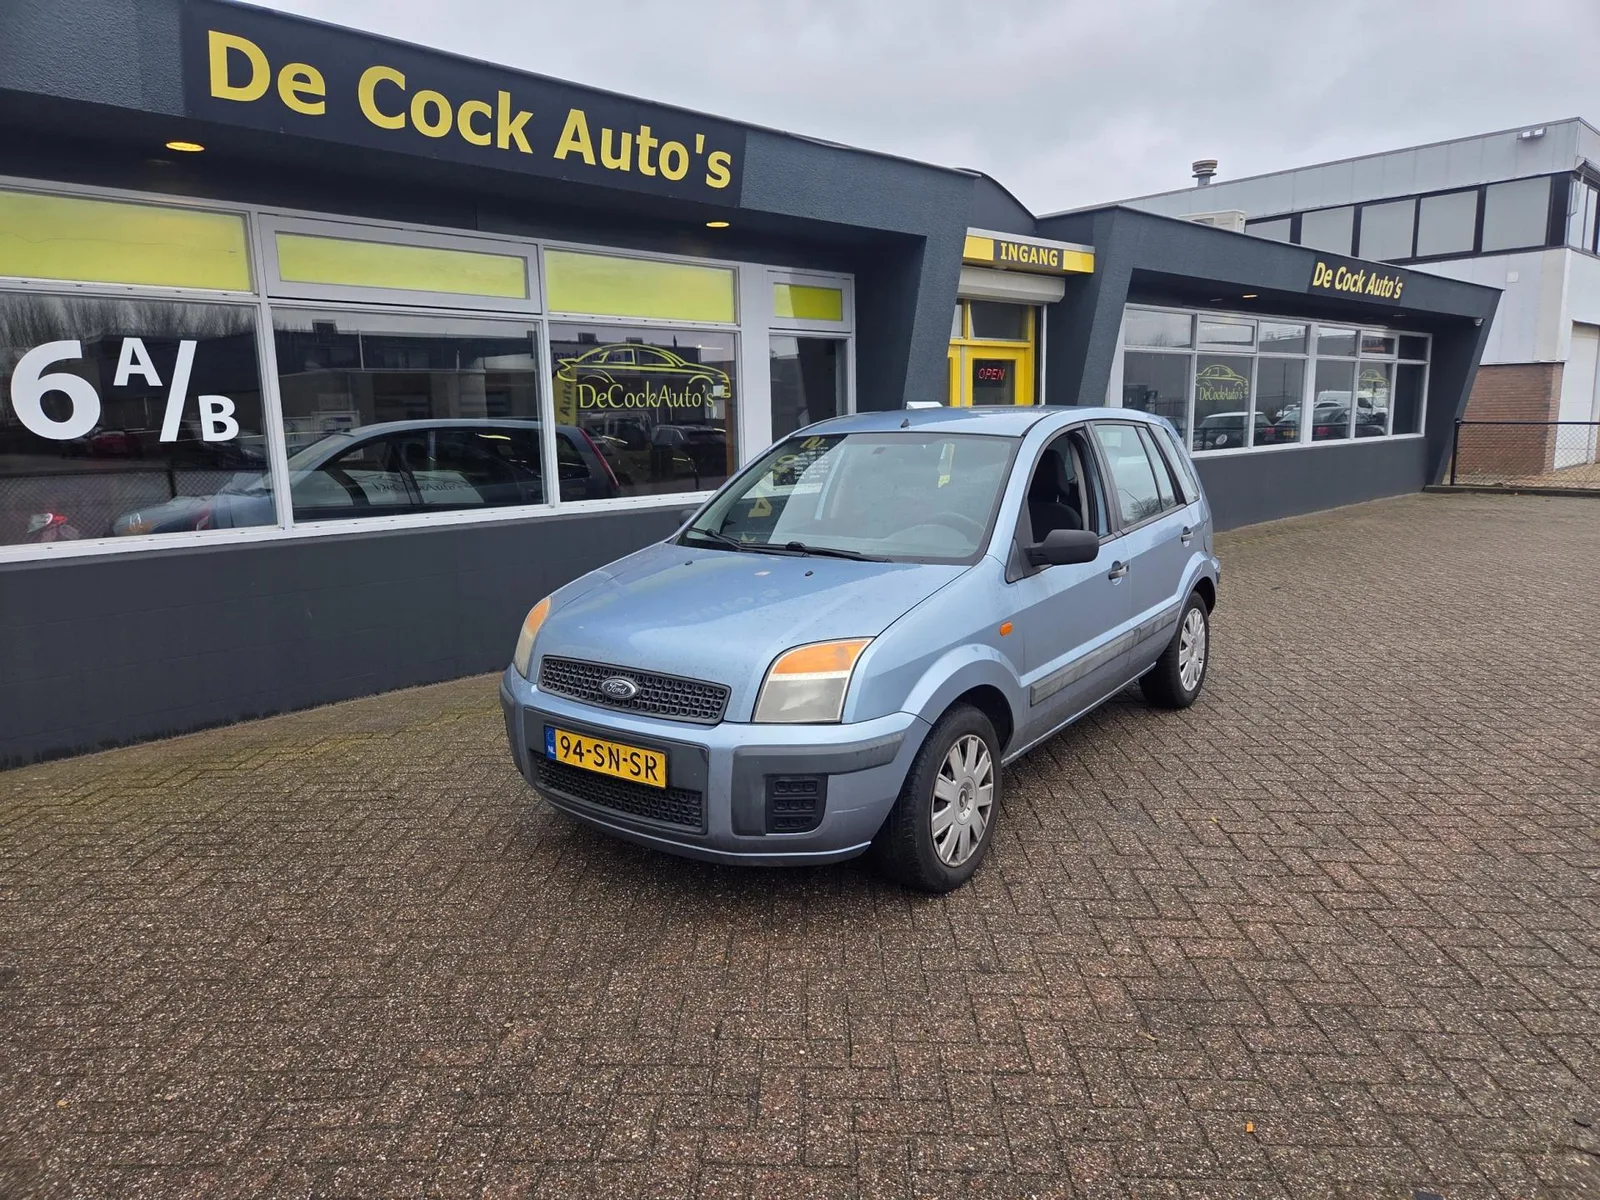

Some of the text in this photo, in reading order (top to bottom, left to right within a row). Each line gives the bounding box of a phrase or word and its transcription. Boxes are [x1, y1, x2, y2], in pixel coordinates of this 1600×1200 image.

[208, 30, 732, 190] De Cock Auto's
[1000, 242, 1058, 267] INGANG
[1312, 262, 1403, 299] De Cock Auto's
[978, 367, 1005, 381] OPEN
[577, 381, 715, 408] DeCockAuto's
[606, 682, 628, 695] Ford
[560, 735, 658, 781] 94-SN-SR
